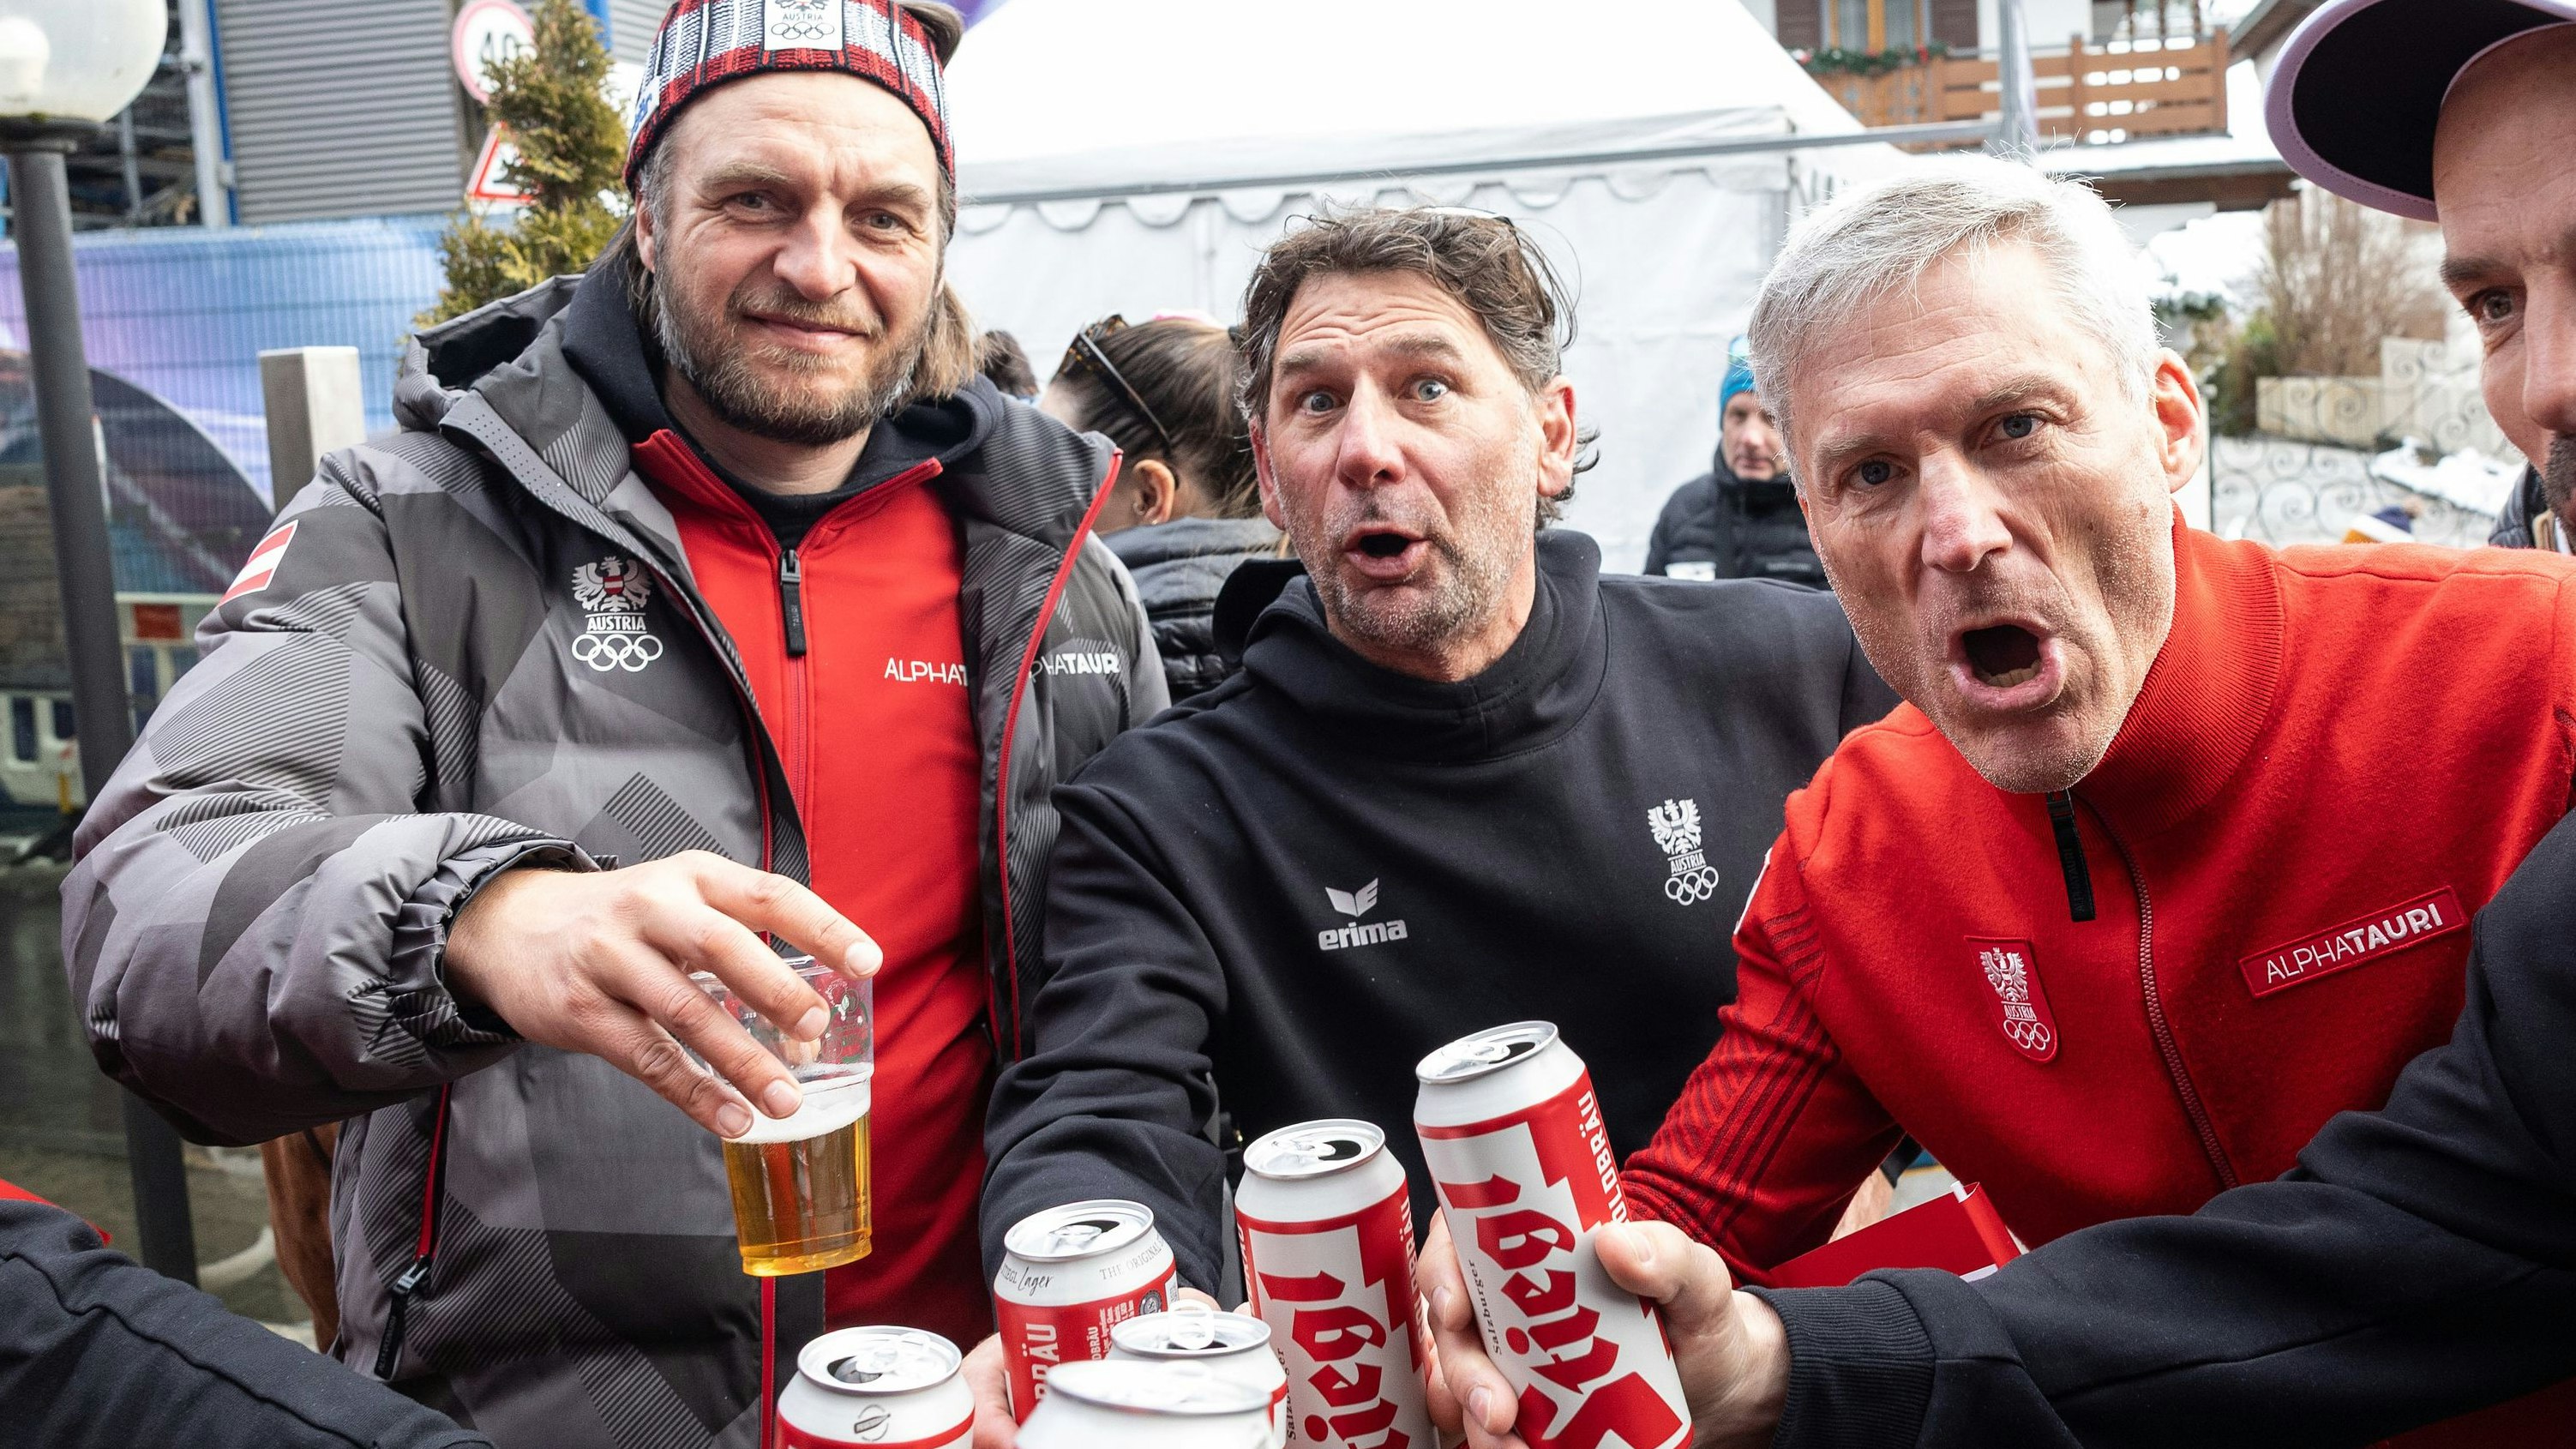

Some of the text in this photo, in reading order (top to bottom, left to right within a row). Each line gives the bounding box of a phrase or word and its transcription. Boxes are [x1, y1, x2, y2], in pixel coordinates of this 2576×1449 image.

[586, 616, 646, 630] AUSTRIA
[1030, 652, 1120, 683] PHATAUR
[1670, 852, 1706, 874] AUSTRIA
[1318, 919, 1408, 951] erima
[2267, 903, 2443, 984] ALPHATAURI
[2003, 1004, 2037, 1020] AUSTRIA
[1577, 1090, 1630, 1224] OLDBRÄU
[1018, 1265, 1054, 1297] Lager
[1099, 1263, 1124, 1280] THE
[1468, 1258, 1502, 1356] Salzburger
[1086, 1326, 1102, 1362] DBRÄU
